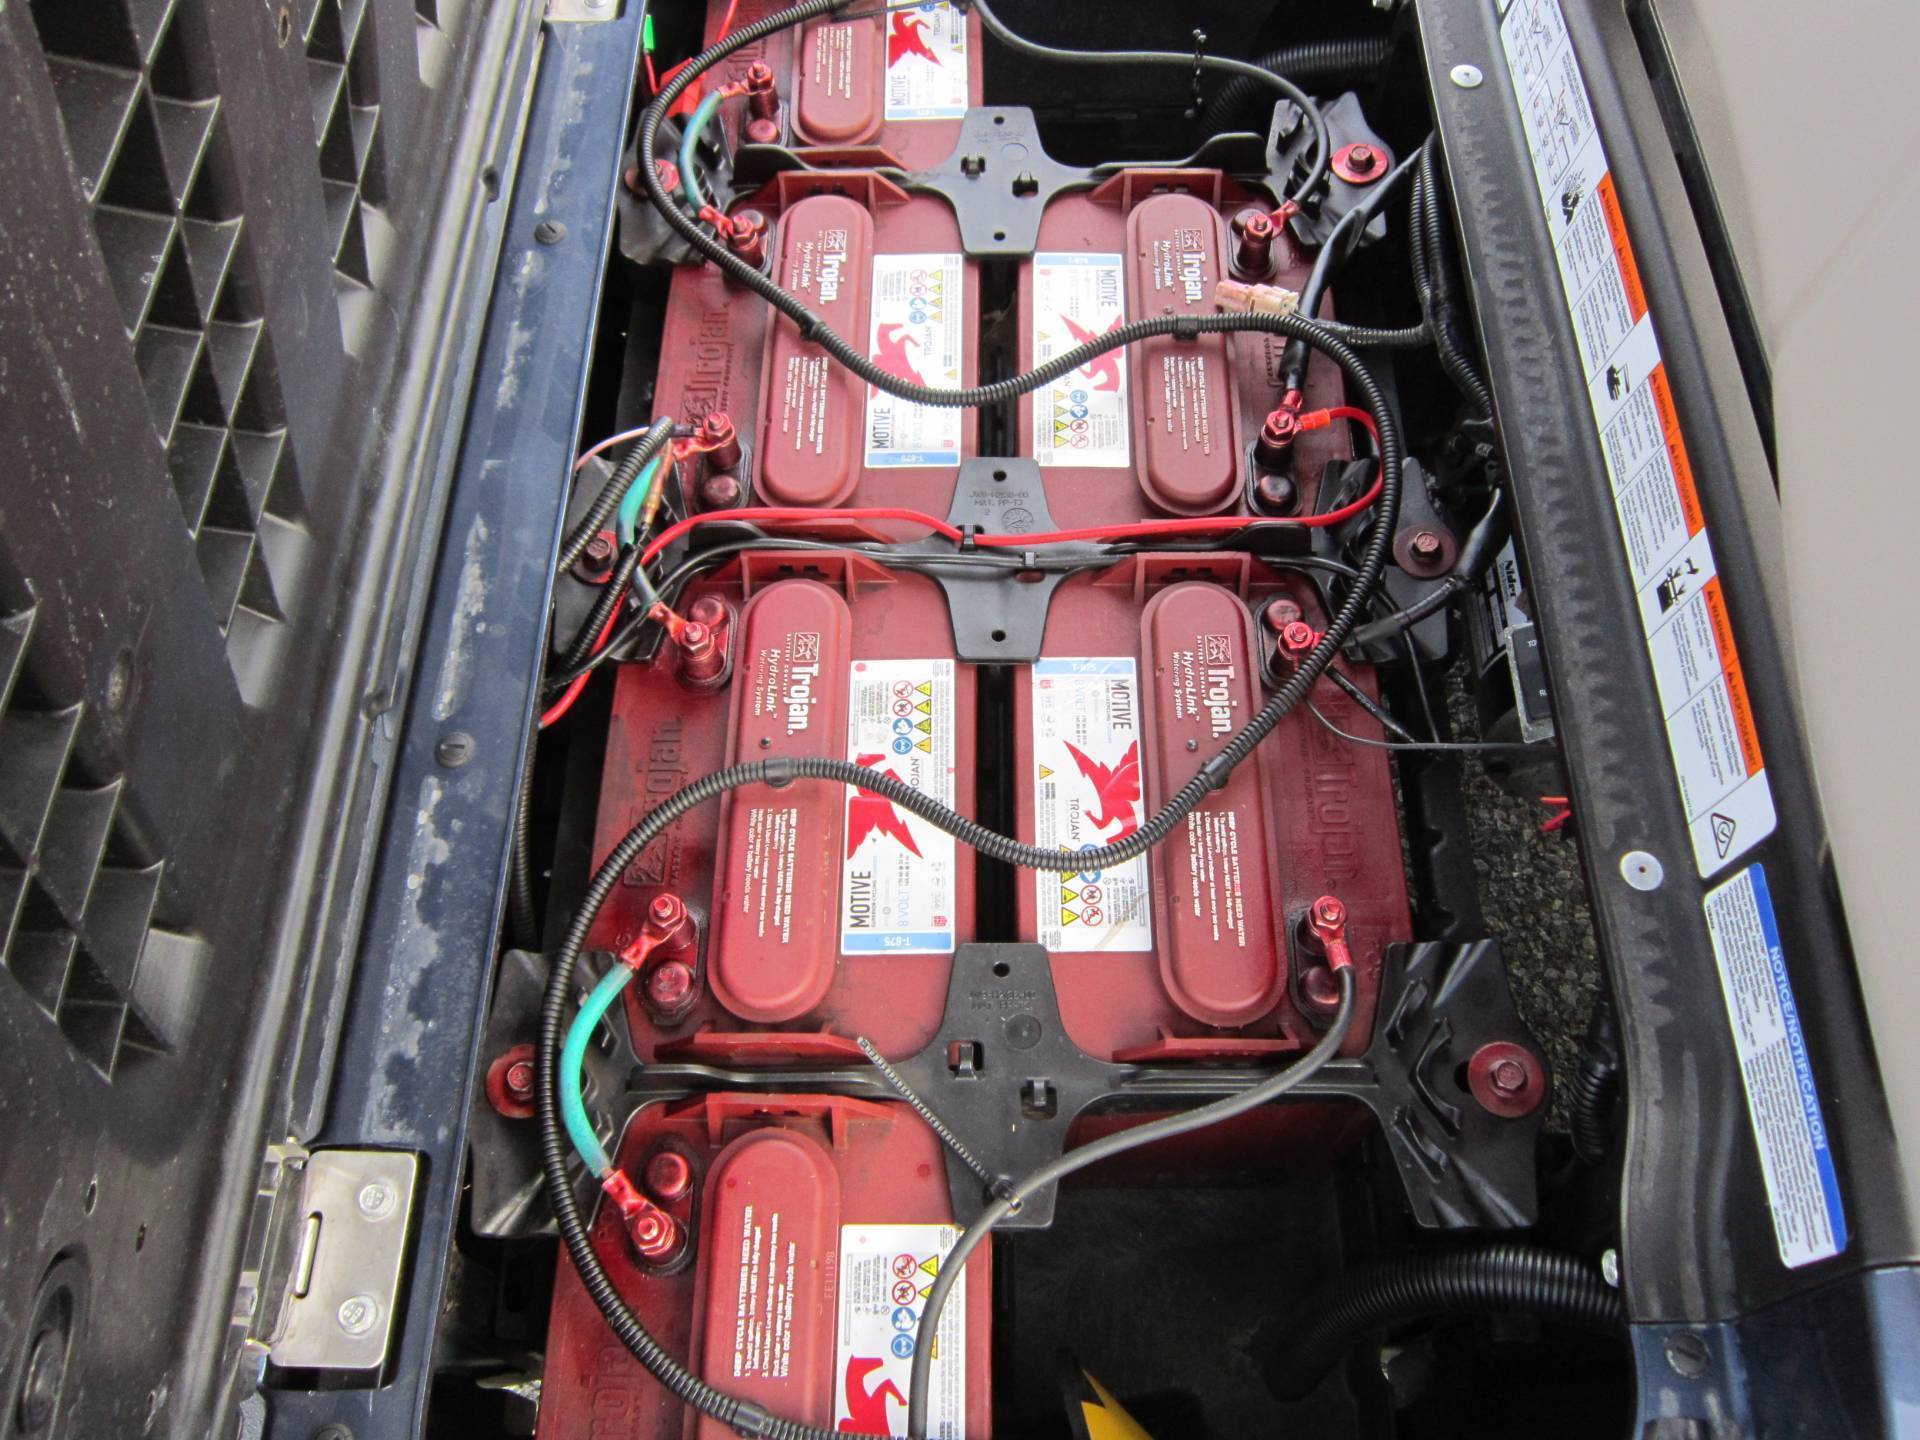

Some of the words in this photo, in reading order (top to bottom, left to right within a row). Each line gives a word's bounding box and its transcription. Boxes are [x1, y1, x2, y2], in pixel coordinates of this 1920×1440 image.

[889, 74, 905, 106] MOTIVE
[1099, 269, 1118, 307] MOTIVE
[870, 407, 891, 448] MOTIVE
[1709, 600, 1729, 658] WARNING
[755, 648, 767, 684] Watering
[1170, 651, 1182, 686] Watering
[753, 686, 764, 715] System
[1110, 678, 1132, 729] MOTIVE
[1173, 688, 1184, 718] System
[748, 808, 757, 826] White
[788, 807, 797, 826] DEEP
[1068, 797, 1081, 840] TROJAN
[1186, 811, 1195, 830] White
[1227, 811, 1235, 829] DEEP
[747, 827, 756, 843] color
[787, 827, 795, 851] CYCLE
[1187, 830, 1196, 846] color
[1228, 830, 1238, 854] CYCLE
[745, 850, 754, 872] battery
[784, 852, 794, 893] BATTERIES
[1189, 853, 1198, 875] battery
[743, 873, 752, 893] needs
[1191, 876, 1200, 896] needs
[1230, 855, 1241, 896] BATTERIES
[742, 894, 751, 913] water
[783, 894, 791, 914] NEED
[848, 870, 871, 927] MOTIVE
[1192, 898, 1202, 916] water
[1234, 897, 1243, 918] NEED
[781, 916, 790, 943] WATER
[1236, 919, 1246, 946] WATER
[1769, 945, 1826, 1151] NOTICE/NOTIFICATION
[743, 1205, 753, 1237] WATER
[741, 1238, 751, 1264] NEED
[787, 1241, 796, 1264] water
[785, 1265, 795, 1290] needs
[737, 1265, 749, 1317] BATTERIES
[783, 1292, 793, 1320] battery
[734, 1318, 745, 1350] CYCLE
[781, 1329, 791, 1350] color
[732, 1351, 742, 1377] DEEP
[779, 1352, 789, 1376] White
